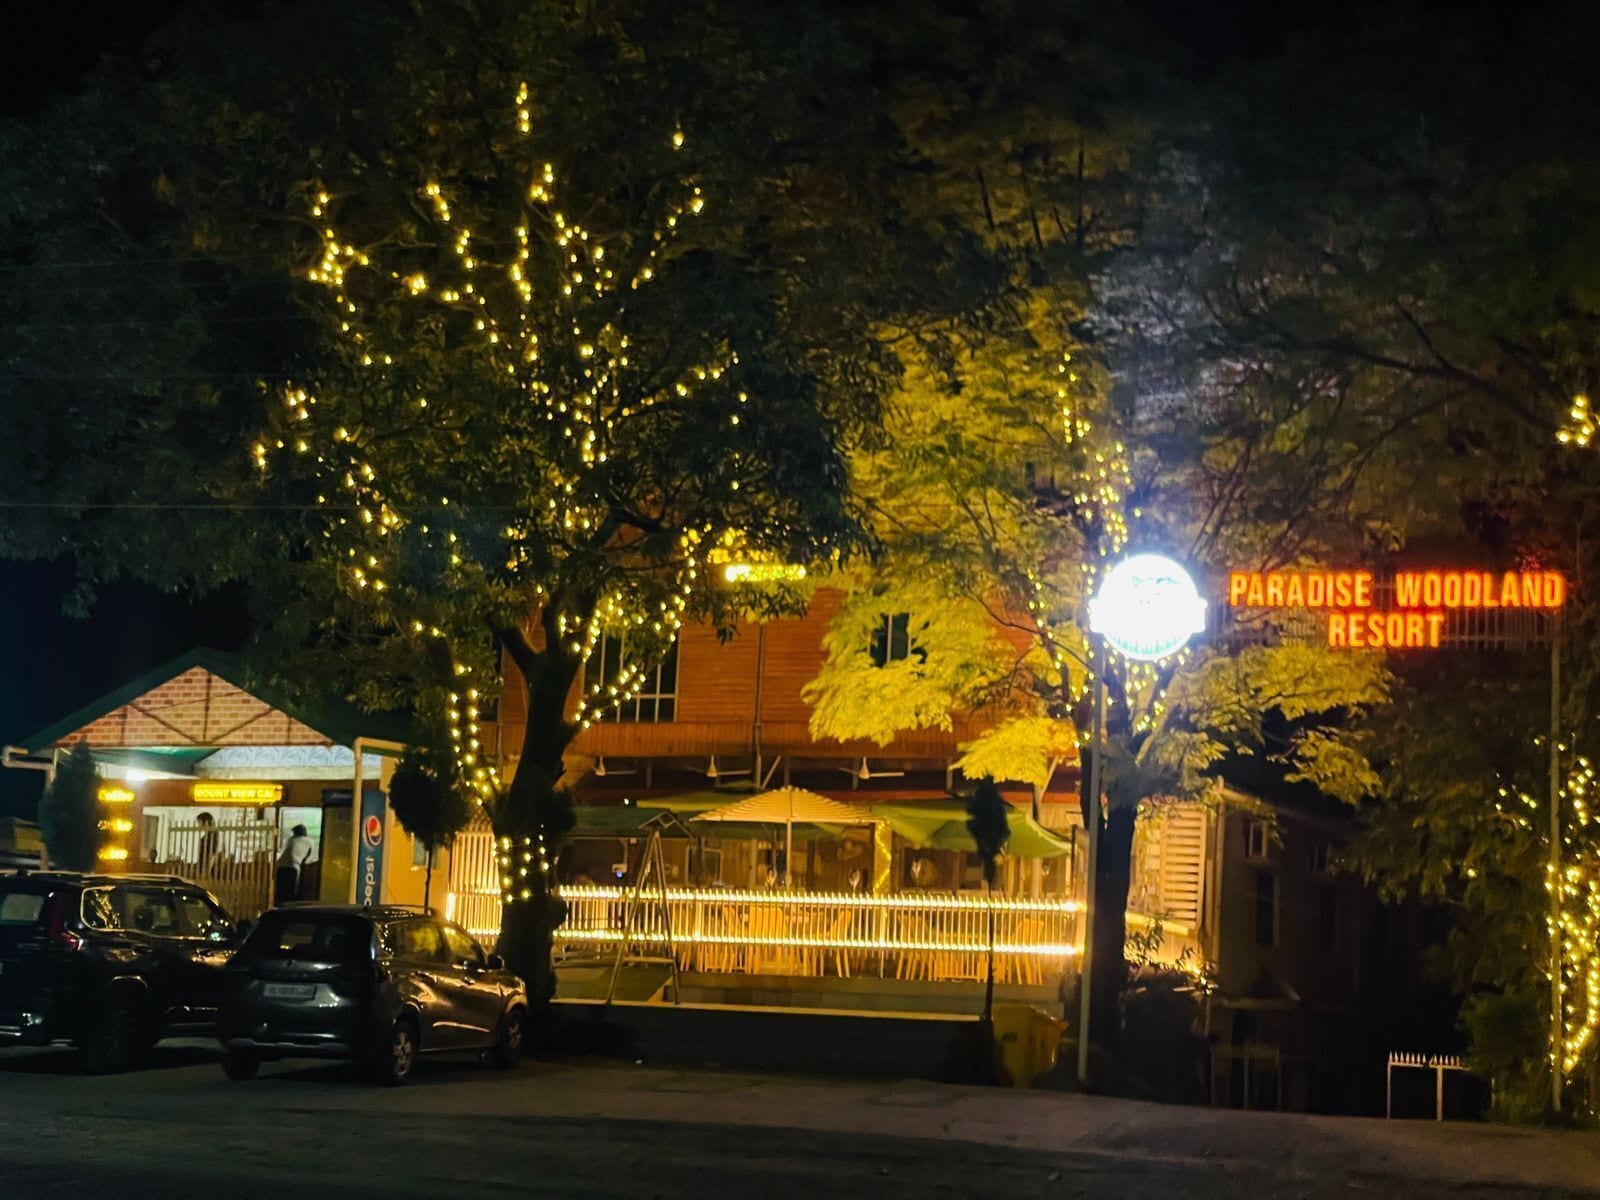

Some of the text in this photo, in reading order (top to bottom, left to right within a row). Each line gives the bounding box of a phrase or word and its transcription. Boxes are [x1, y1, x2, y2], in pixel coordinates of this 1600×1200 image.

[1230, 572, 1567, 608] PARADISE WOODLAND
[1328, 613, 1445, 648] RESORT
[231, 788, 255, 798] VIEW
